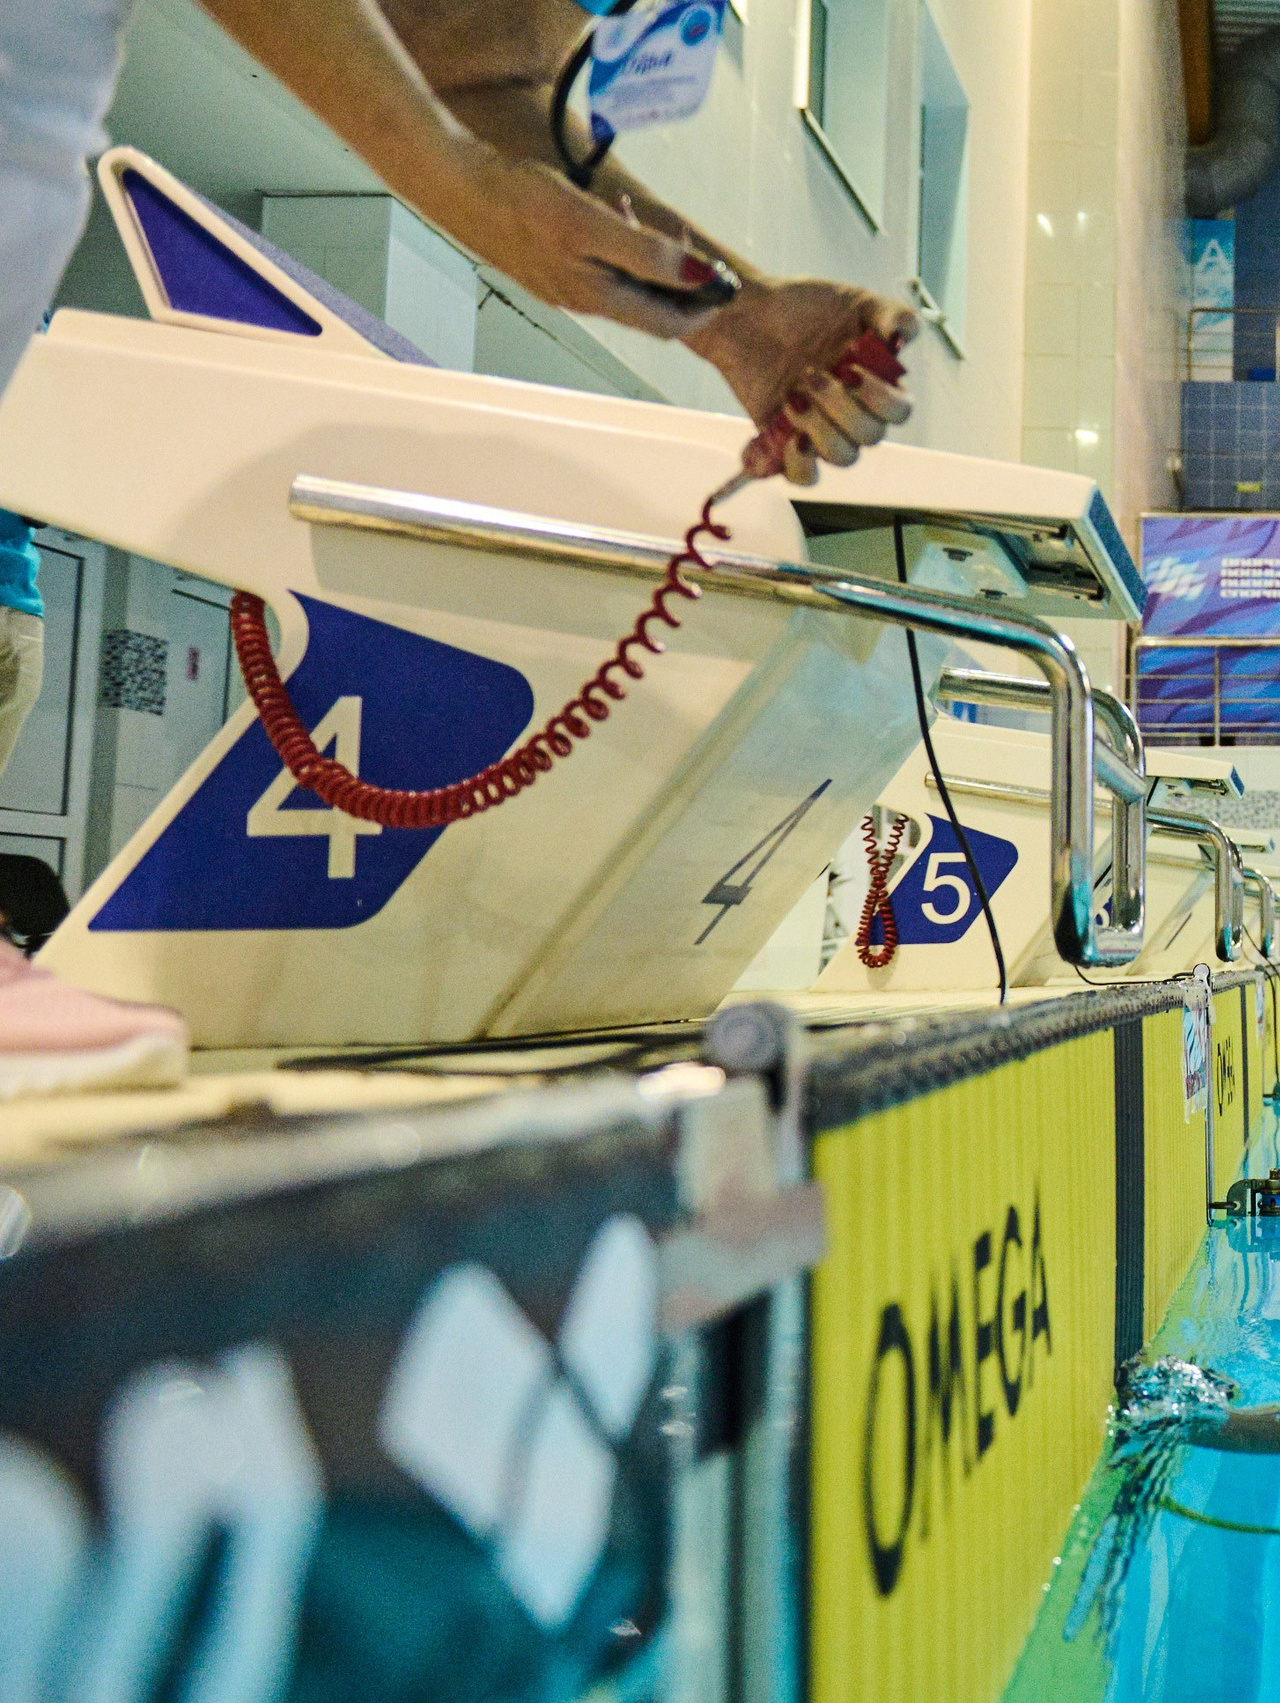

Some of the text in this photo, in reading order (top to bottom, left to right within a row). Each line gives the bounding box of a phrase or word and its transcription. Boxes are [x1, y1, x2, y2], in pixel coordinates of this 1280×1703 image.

[247, 695, 383, 879] 4
[694, 778, 834, 946] 4
[920, 851, 971, 925] 5
[862, 1176, 1052, 1598] OMEGA
